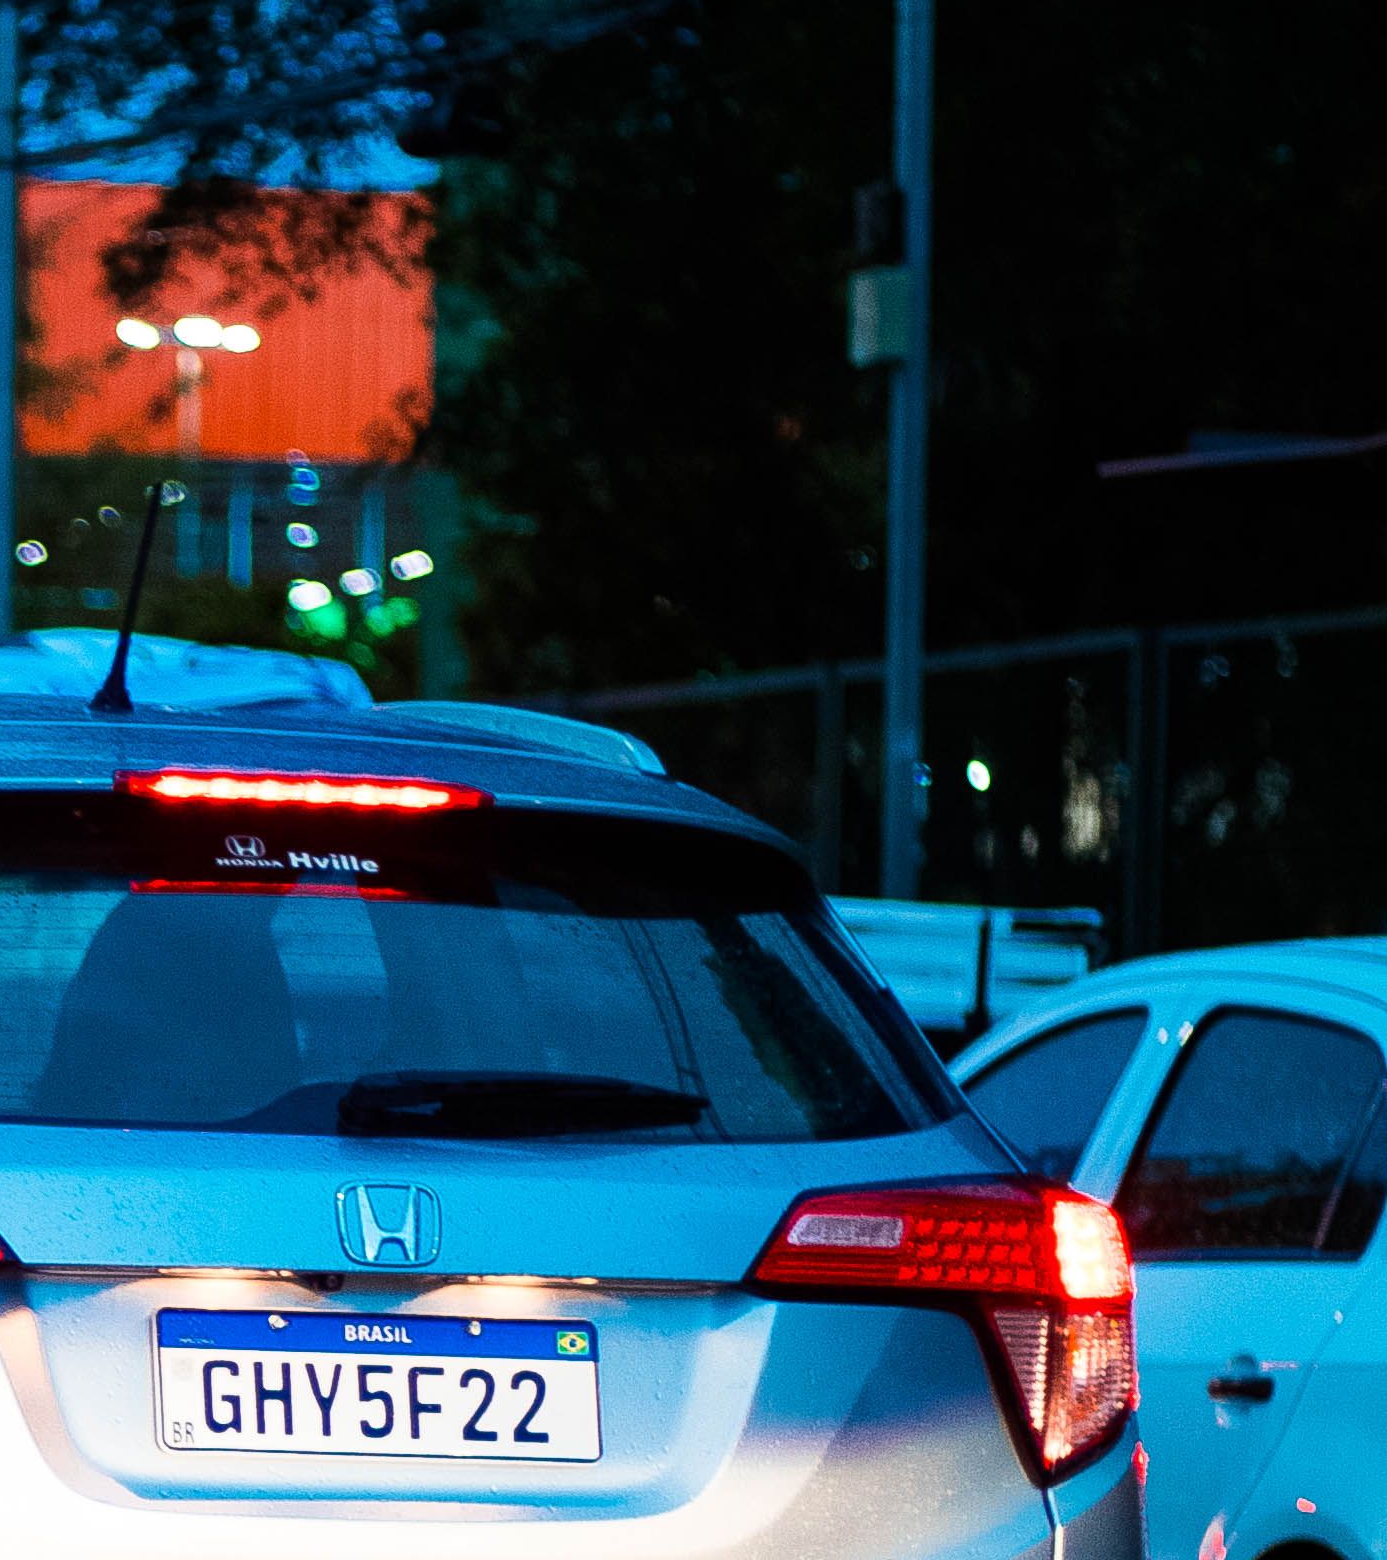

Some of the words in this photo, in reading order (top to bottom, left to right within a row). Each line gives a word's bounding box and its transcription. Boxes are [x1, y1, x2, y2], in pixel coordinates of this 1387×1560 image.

[214, 857, 285, 869] HONDA
[287, 850, 380, 873] Hville
[343, 1324, 413, 1345] BRASIL
[202, 1359, 550, 1445] GHY5F22
[172, 1421, 195, 1445] BR
